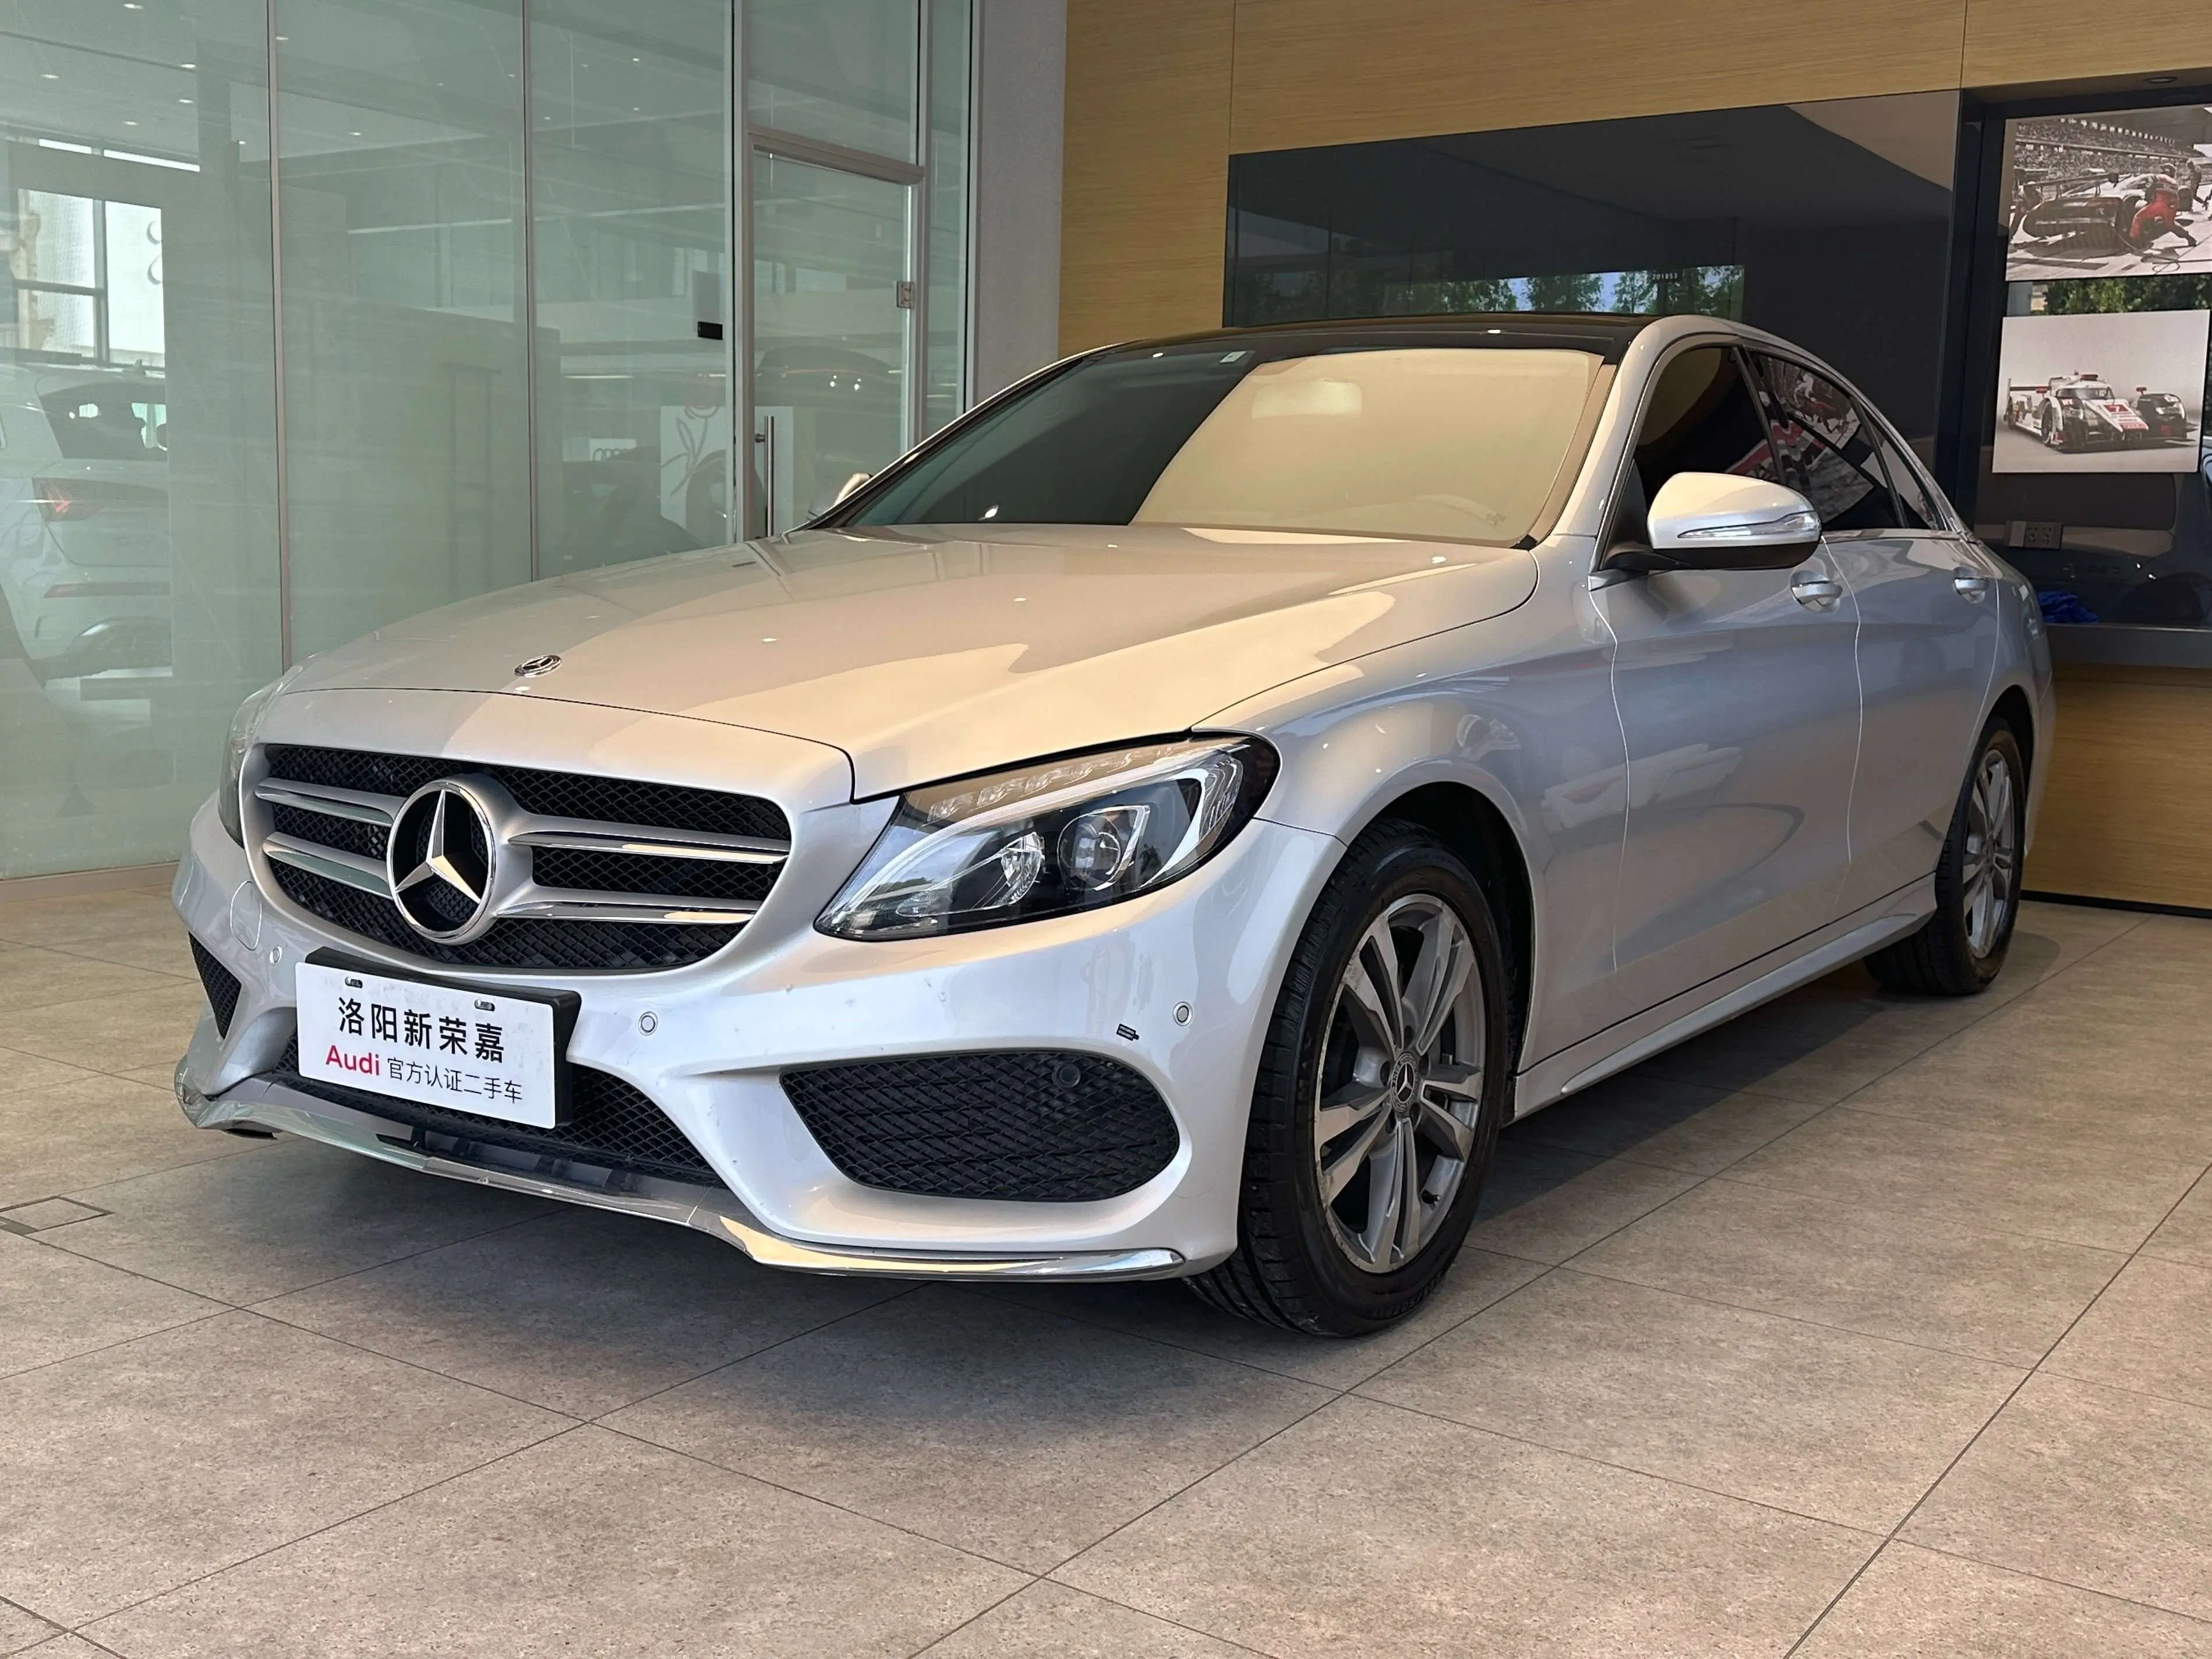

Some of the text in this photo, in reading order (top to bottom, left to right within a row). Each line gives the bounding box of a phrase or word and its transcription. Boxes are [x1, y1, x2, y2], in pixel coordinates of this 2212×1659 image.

[338, 997, 504, 1064] 洛阳新荣嘉
[325, 1045, 523, 1104] Audi 官方认证二手车
